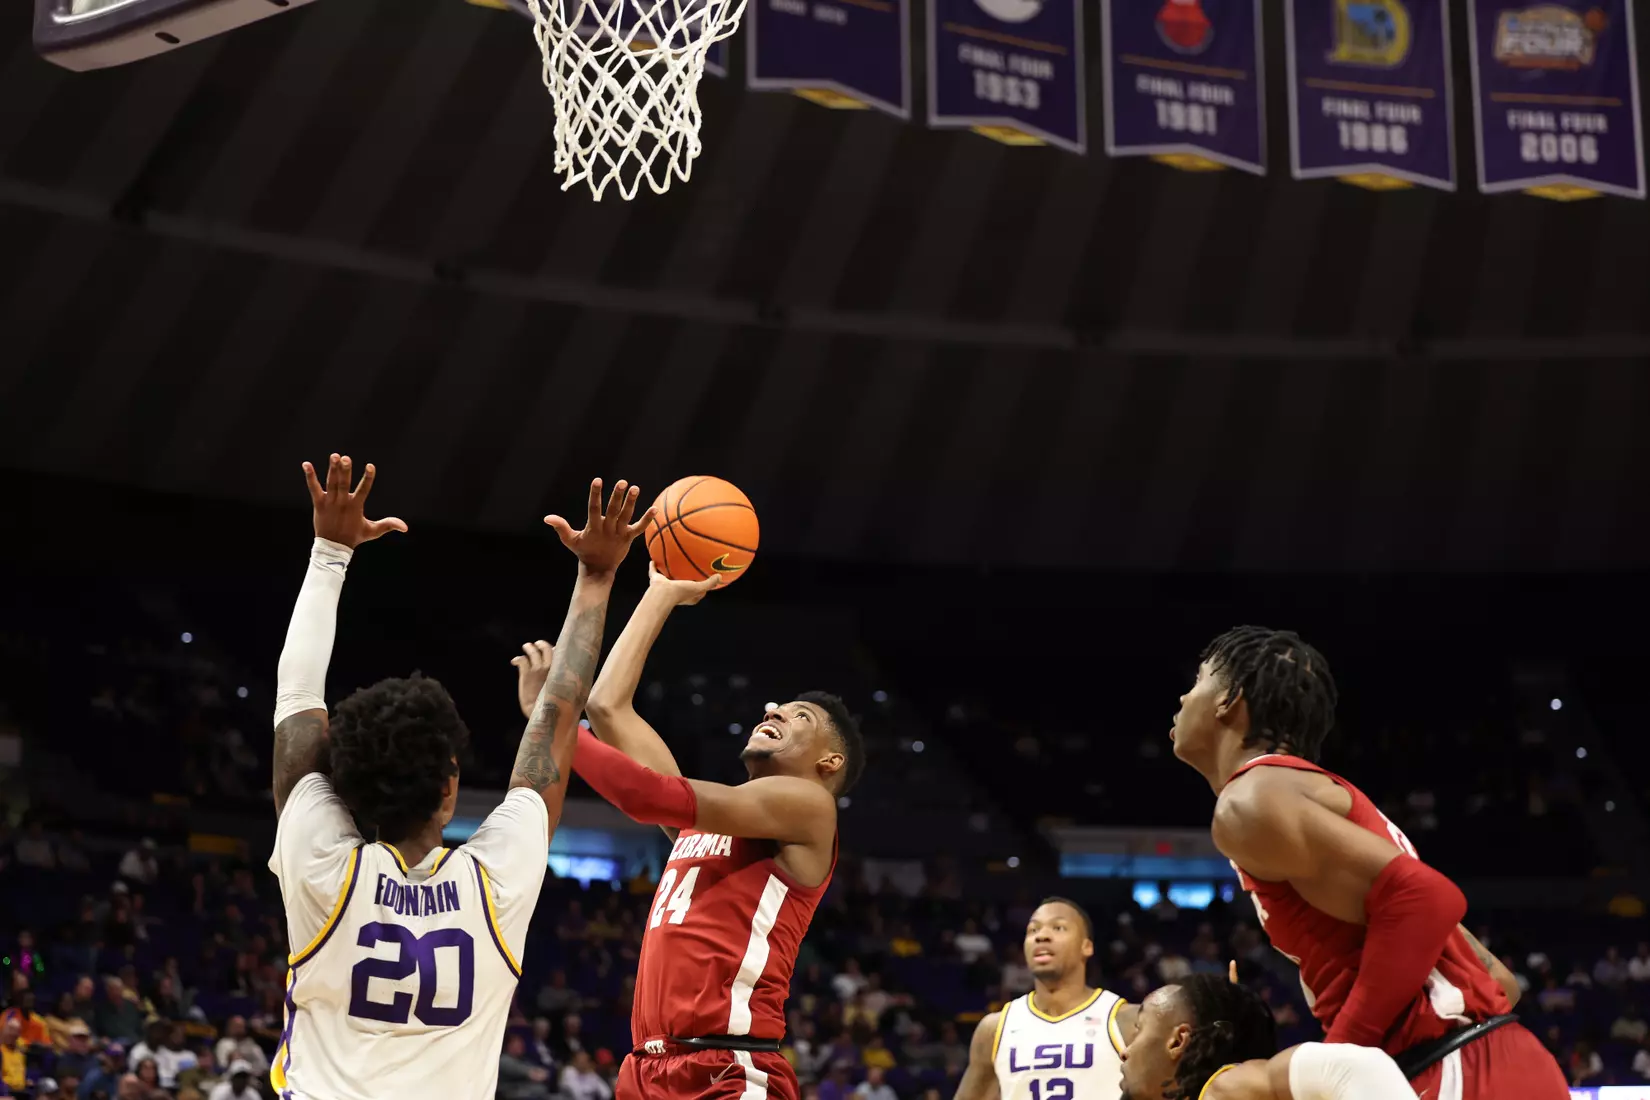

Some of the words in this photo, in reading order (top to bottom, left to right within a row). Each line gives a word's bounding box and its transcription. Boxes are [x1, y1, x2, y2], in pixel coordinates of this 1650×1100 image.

[1007, 53, 1054, 80] FOUR
[973, 68, 1040, 110] 1953
[1136, 73, 1184, 99] FINAL
[1186, 81, 1234, 106] FOUR
[1155, 98, 1217, 136] 1981
[1321, 96, 1371, 121] FINAL
[1374, 101, 1422, 125] FOUR
[1506, 109, 1557, 131] FINAL
[1560, 112, 1608, 134] FOUR
[1520, 132, 1599, 165] 2006
[667, 833, 733, 863] LABAMA
[374, 873, 461, 917] FOUNTAIN
[650, 866, 701, 930] 24
[348, 921, 474, 1026] 20
[1010, 1043, 1094, 1073] LSU
[1029, 1078, 1074, 1100] 12
